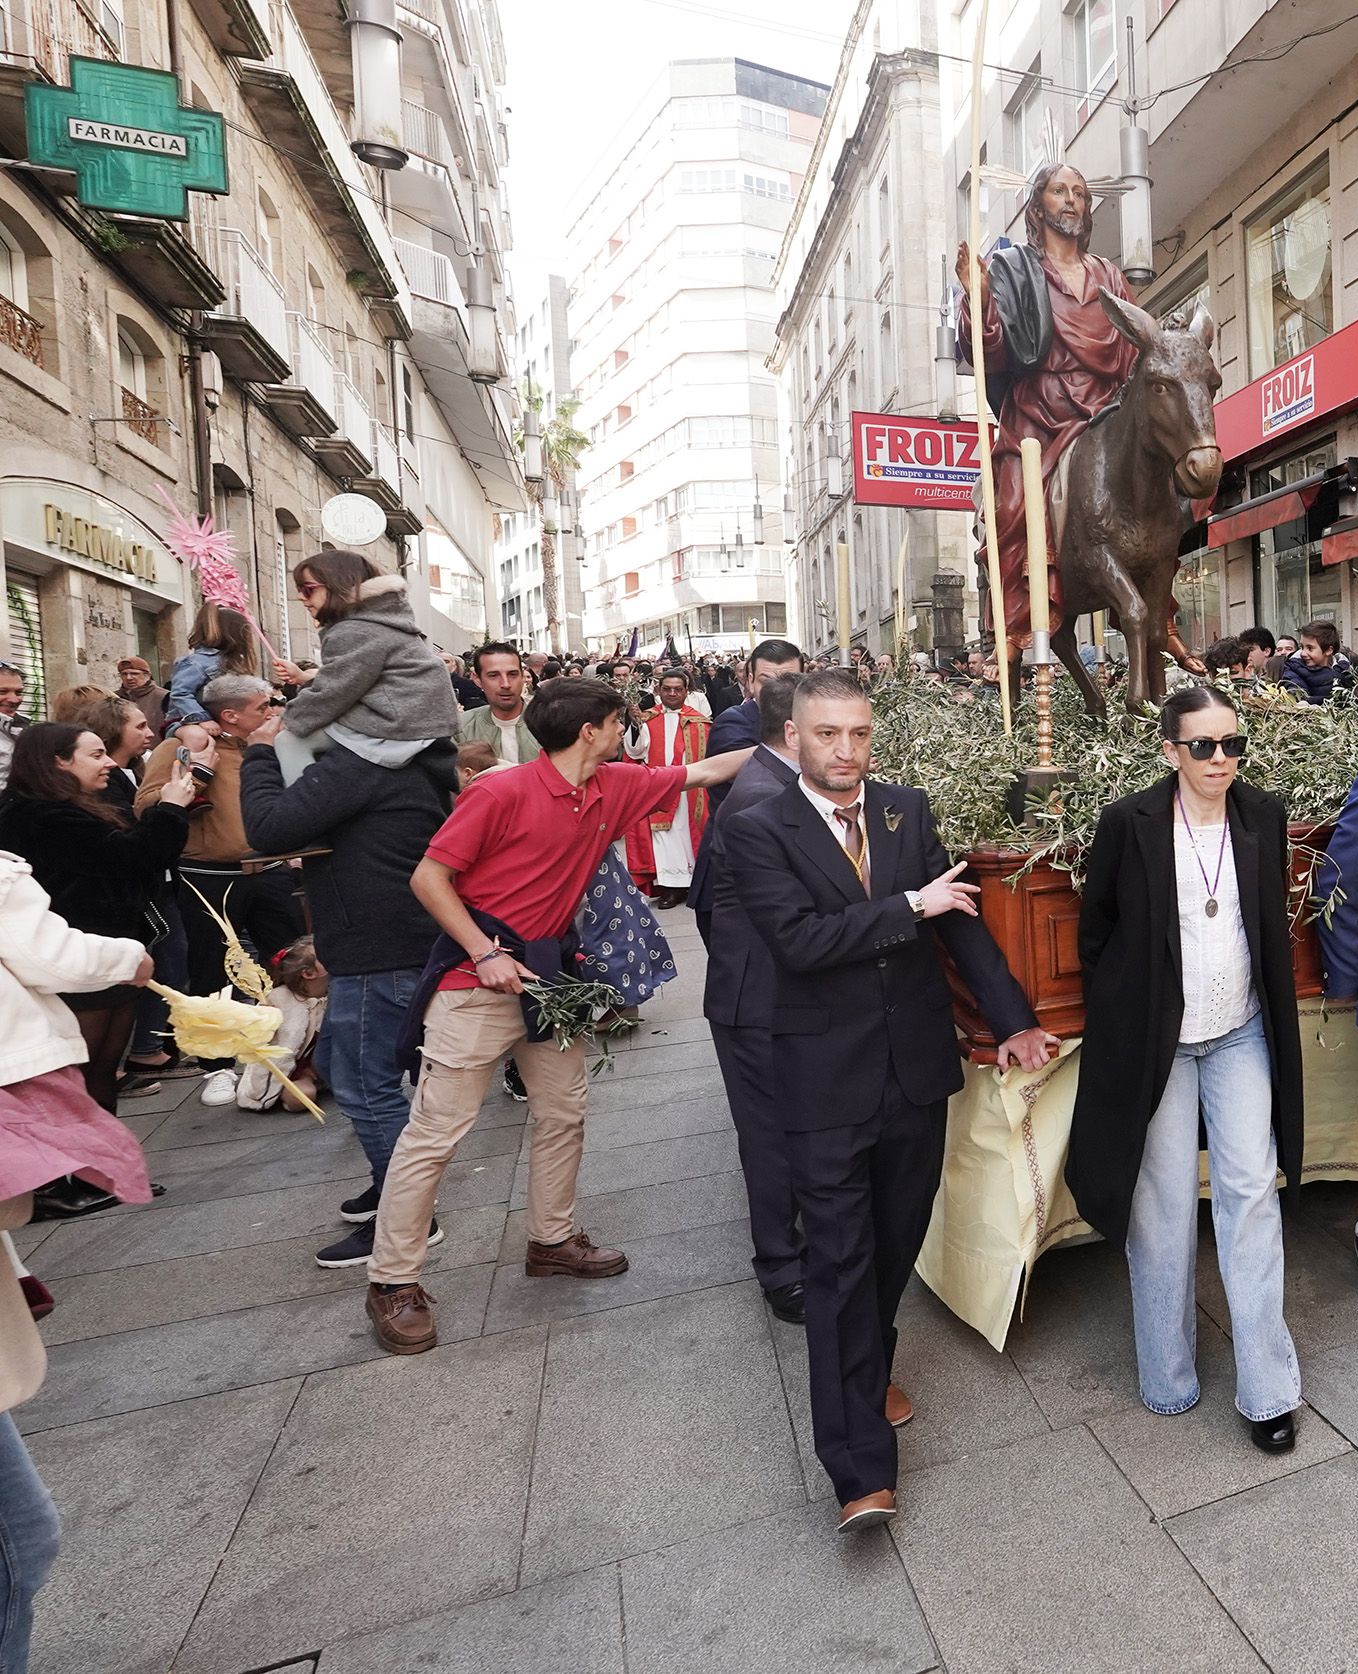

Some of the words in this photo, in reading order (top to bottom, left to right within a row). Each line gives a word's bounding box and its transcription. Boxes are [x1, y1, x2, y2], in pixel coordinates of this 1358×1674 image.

[75, 123, 182, 152] FARMACIA
[1263, 358, 1312, 417] FROIZ
[866, 427, 981, 468] FROIZ
[885, 466, 923, 478] Siempre
[934, 471, 945, 479] su
[914, 485, 973, 500] multicent
[44, 503, 159, 584] FARMACIA
